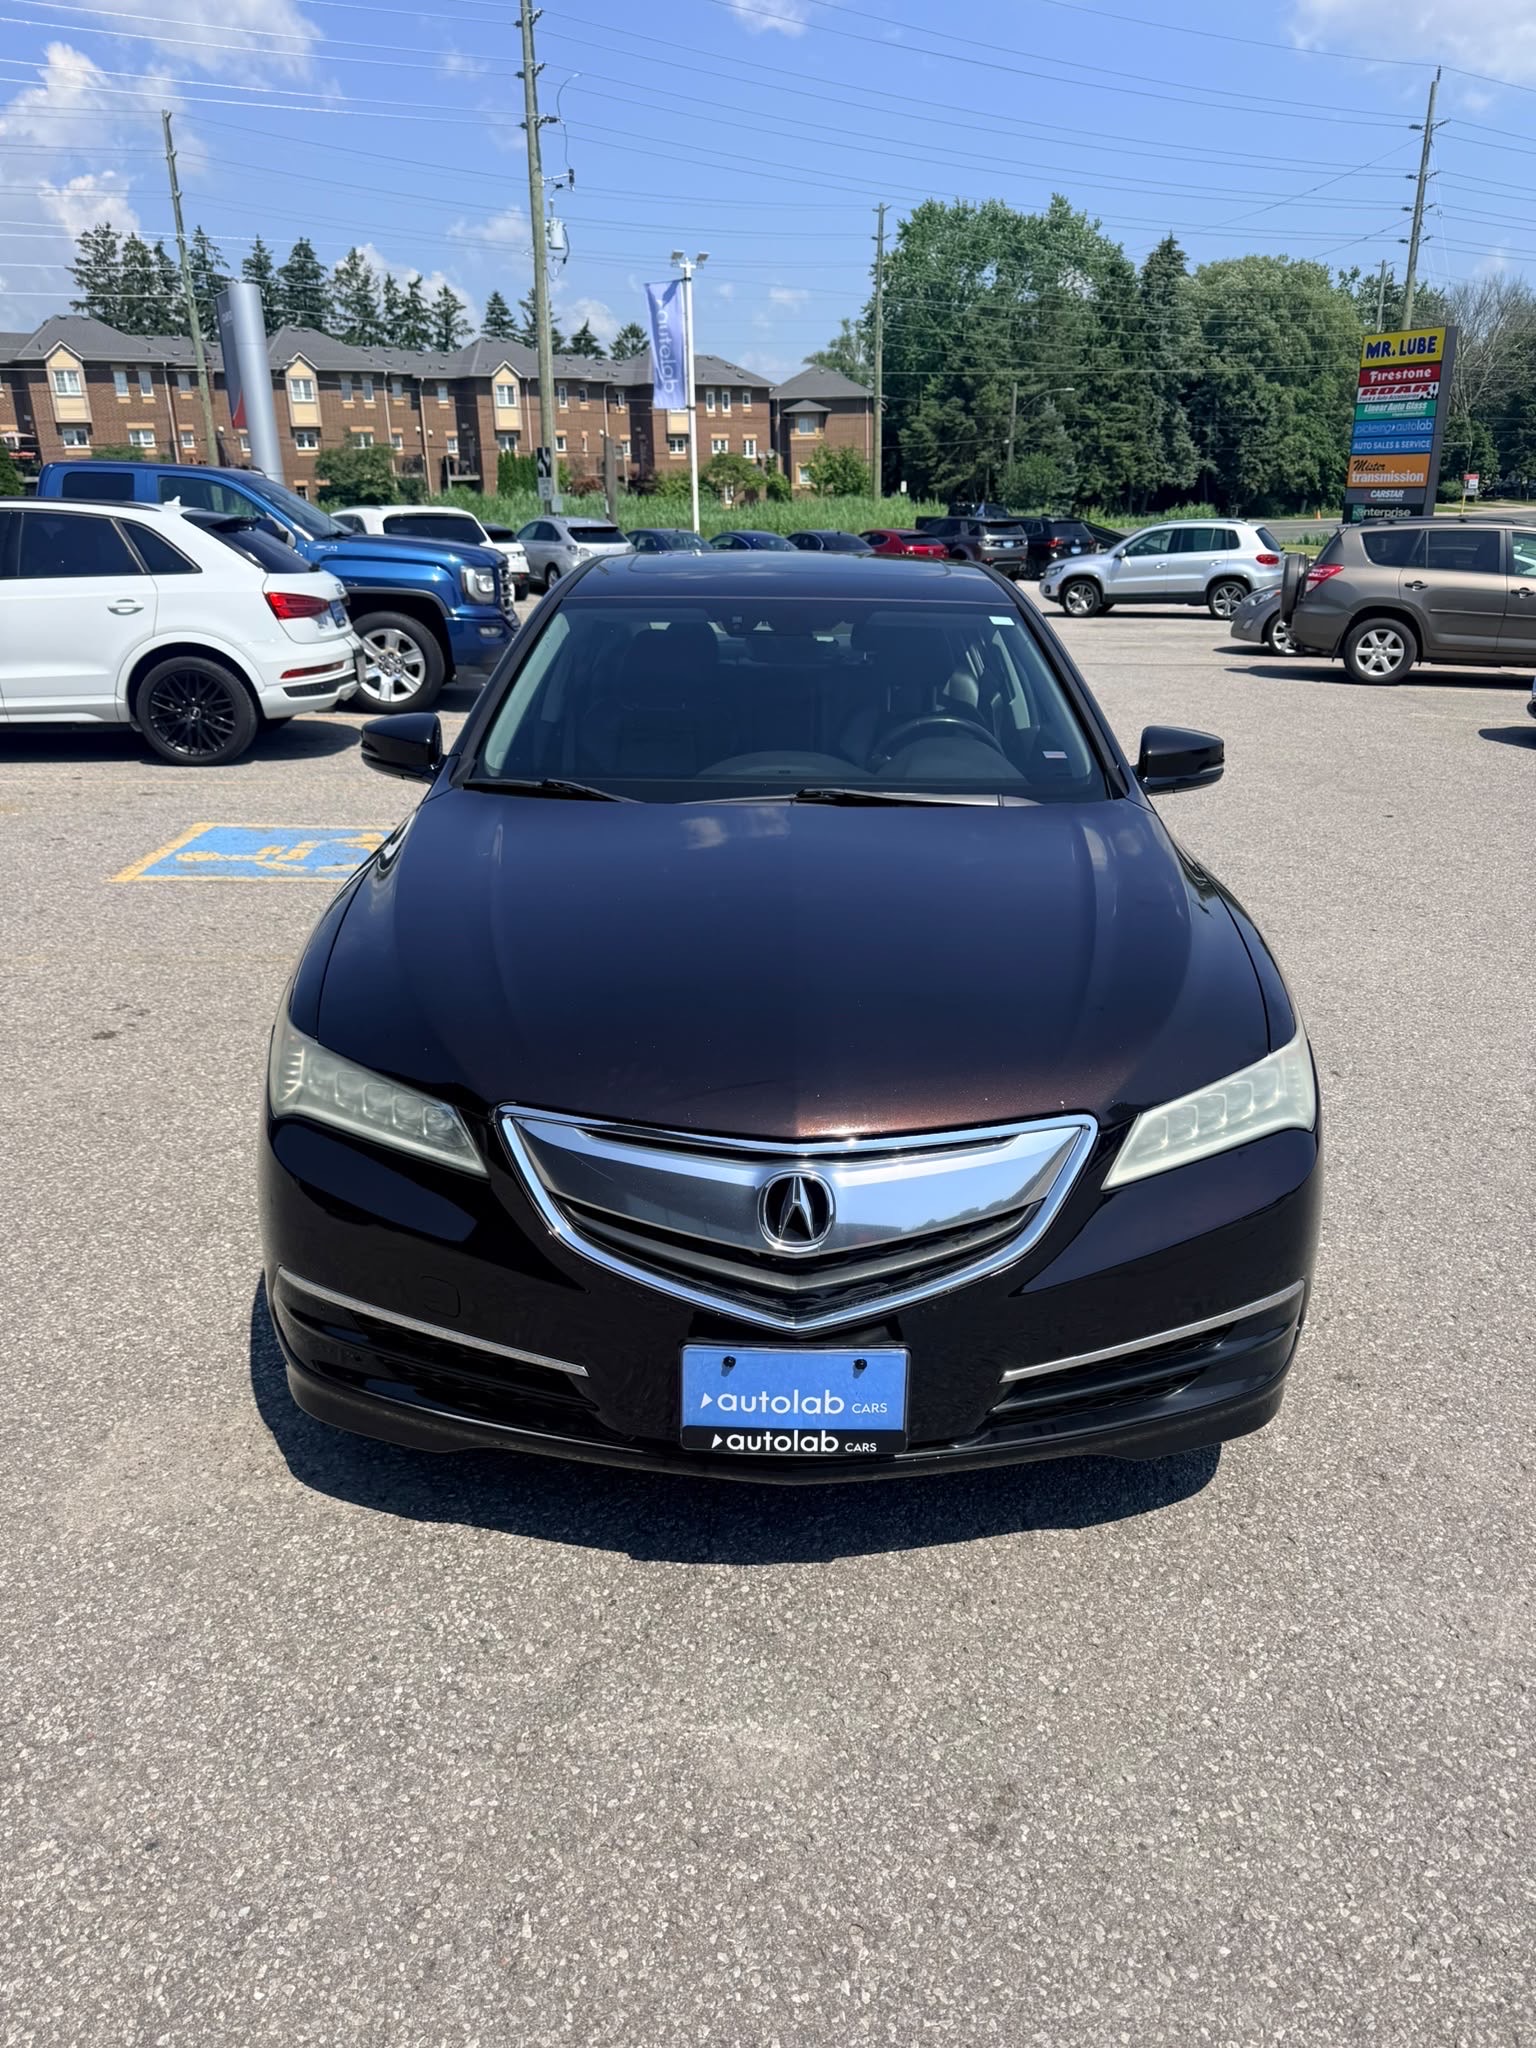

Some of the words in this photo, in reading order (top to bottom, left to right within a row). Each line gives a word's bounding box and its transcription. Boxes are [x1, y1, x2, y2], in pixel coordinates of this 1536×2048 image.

[1366, 340, 1396, 359] MR.
[1399, 336, 1437, 356] LUBE
[1369, 368, 1432, 384] Firestone
[1361, 384, 1431, 396] ROAR
[1364, 403, 1388, 413] Linear
[1387, 402, 1405, 412] Auto
[1406, 401, 1428, 411] Glass
[1353, 441, 1373, 450] AUTO
[1373, 440, 1394, 449] SALES
[1394, 440, 1400, 449] &
[1401, 439, 1431, 449] SERVICE
[1353, 459, 1386, 471] Mister
[1351, 470, 1424, 483] transmission
[1370, 489, 1405, 498] CARSTAR
[717, 1389, 845, 1415] autolab
[851, 1402, 888, 1414] CARS
[726, 1430, 839, 1452] autolab
[845, 1442, 877, 1453] CARS
